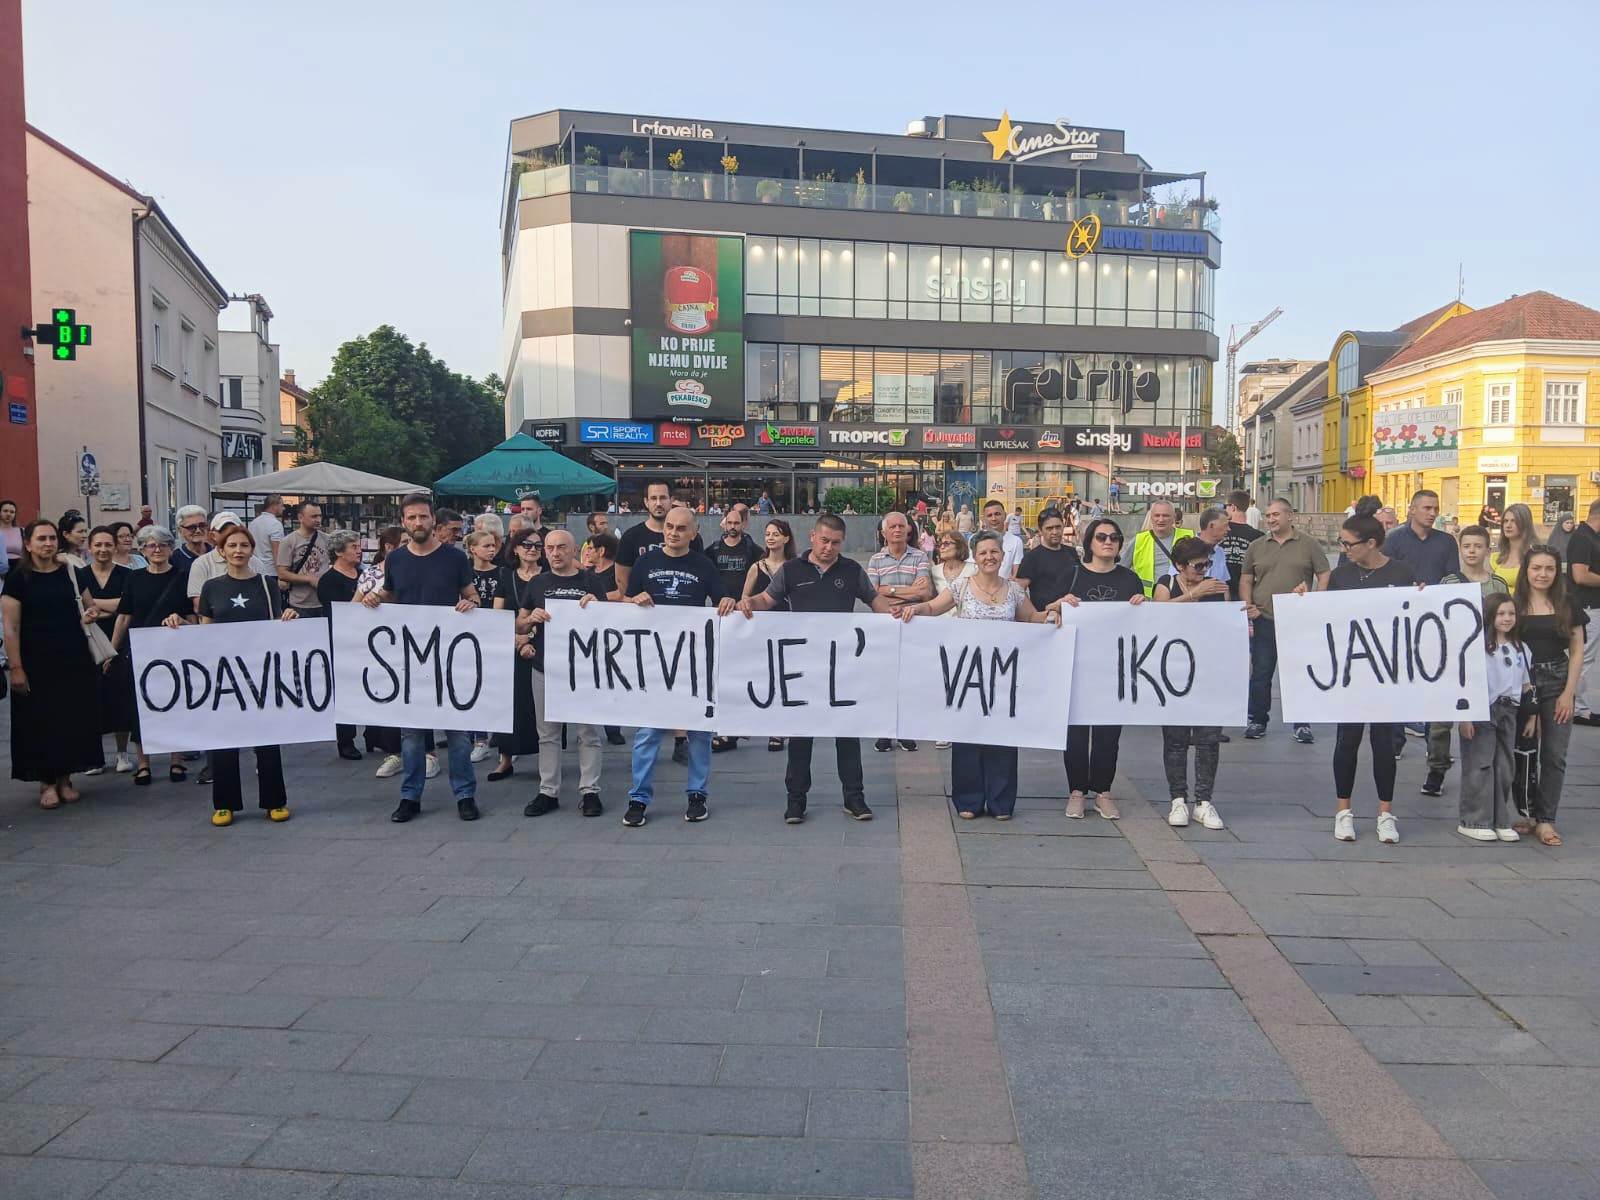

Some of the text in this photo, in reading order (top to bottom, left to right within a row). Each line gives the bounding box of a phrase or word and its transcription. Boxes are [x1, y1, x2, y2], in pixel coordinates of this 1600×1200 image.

[927, 267, 1026, 312] sinsay
[660, 336, 716, 352] KO PRIJE
[648, 353, 728, 370] NJEMU DVIJE
[670, 394, 708, 405] PEKABESKO
[535, 428, 560, 438] KOFEIN
[586, 425, 609, 439] SR
[662, 430, 688, 439] m:tel
[828, 430, 888, 444] TROPIC
[1075, 428, 1132, 451] sinsay
[779, 436, 815, 446] apoteka
[983, 440, 1030, 449] KUPREŠAK
[1126, 482, 1195, 496] TROPIC
[362, 623, 483, 711] SMO
[568, 618, 715, 718] MRTVI!
[747, 637, 808, 709] JE
[1117, 633, 1196, 707] IKO
[139, 648, 332, 713] ODAVNO
[938, 643, 1020, 718] VAM
